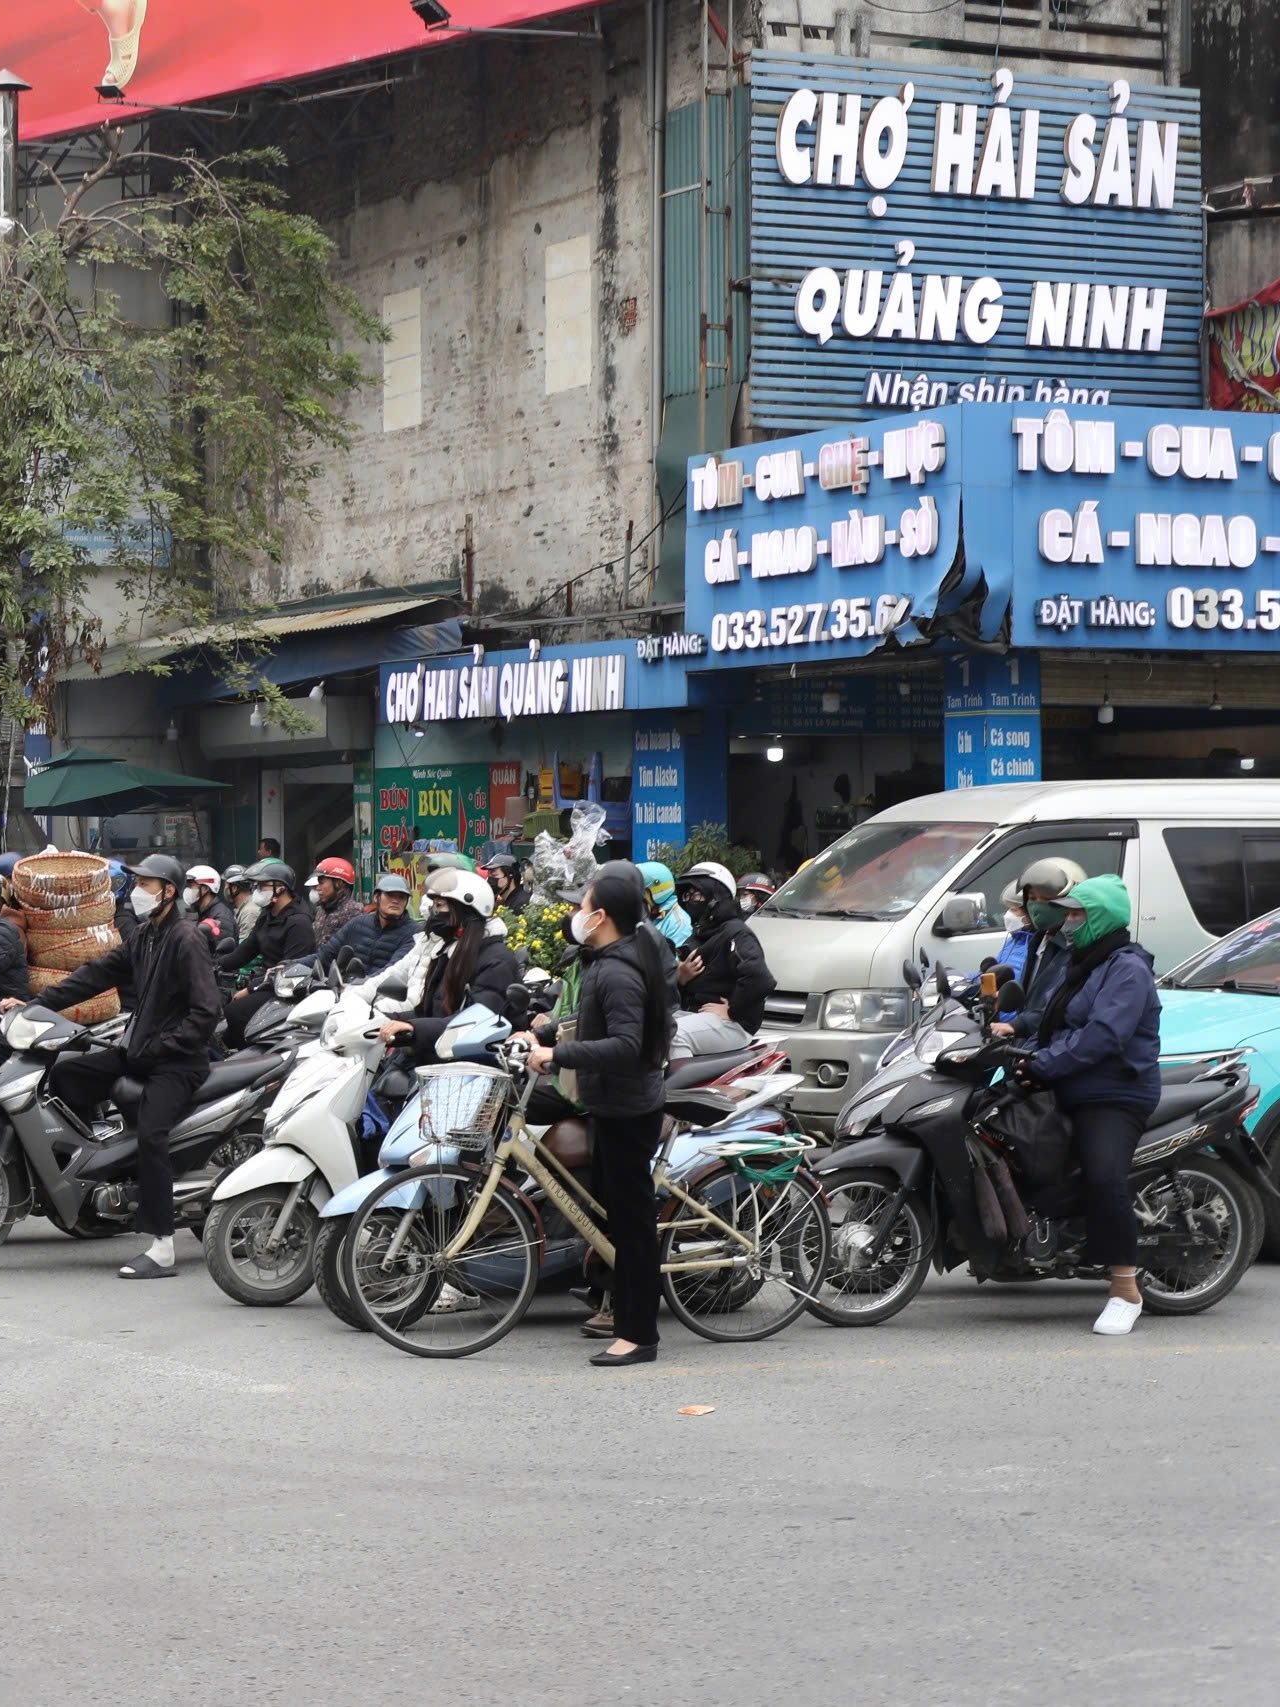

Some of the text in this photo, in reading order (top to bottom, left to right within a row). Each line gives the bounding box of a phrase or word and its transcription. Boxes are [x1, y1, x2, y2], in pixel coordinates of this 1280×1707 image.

[776, 67, 1179, 218] CHỢ HẢI SẢN
[794, 240, 1168, 352] QUẢNG NINH
[865, 370, 953, 411] Nhận
[1039, 595, 1084, 632] ĐẶT
[1090, 595, 1156, 628] HÀNG:
[663, 631, 702, 656] HÀNG:
[458, 644, 499, 719] SẢN
[499, 638, 568, 724] QUẢNG
[571, 654, 625, 713] NINH
[1006, 658, 1020, 686] 1
[947, 695, 962, 709] Tam
[991, 692, 1036, 706] Tam Trinh
[990, 727, 1030, 749] Cá song
[491, 766, 517, 785] QUÁN
[638, 765, 678, 788] Tôm Alaska
[991, 758, 1005, 777] Cá
[379, 782, 409, 810] BÚN
[417, 781, 454, 817] BÚN
[657, 801, 682, 824] canada
